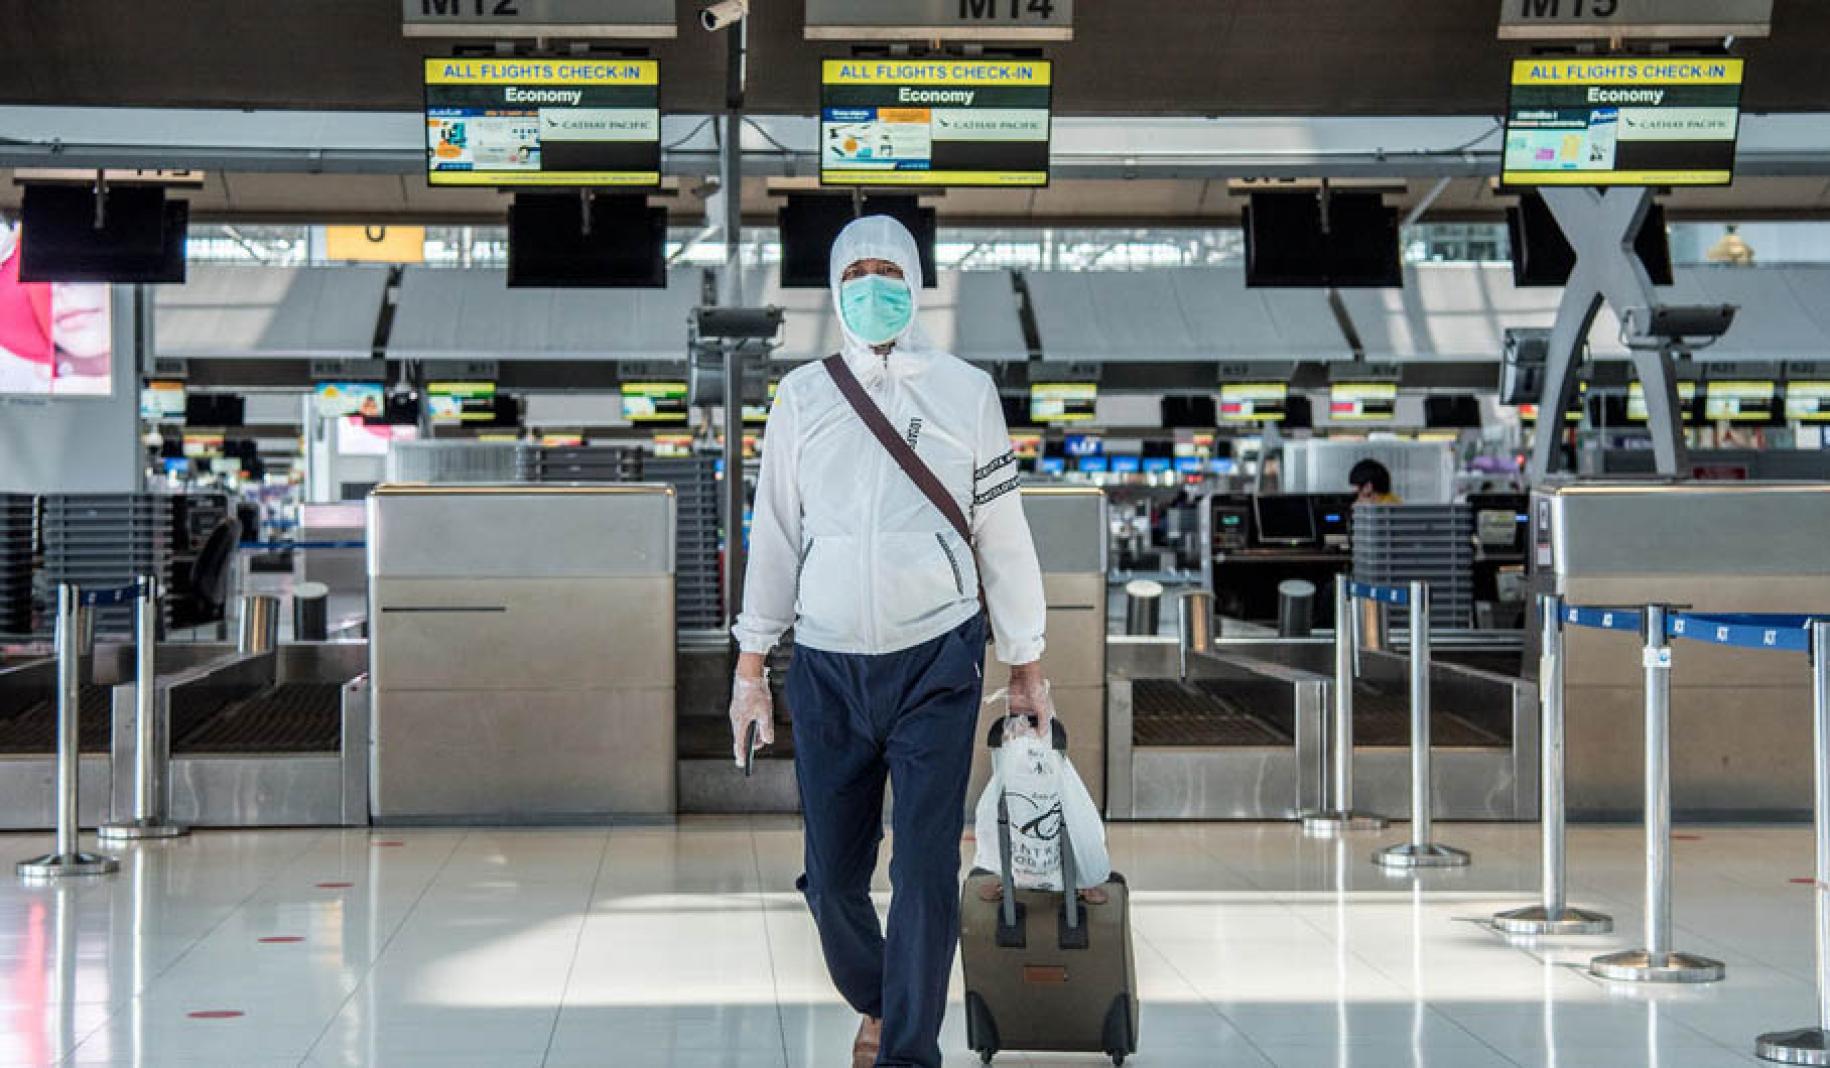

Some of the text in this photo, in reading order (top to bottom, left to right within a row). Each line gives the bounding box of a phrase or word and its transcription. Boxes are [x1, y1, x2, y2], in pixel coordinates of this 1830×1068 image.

[443, 64, 640, 79] ALL FLIGHTS CHECK-IN
[839, 65, 1033, 80] ALL FLIGHTS CHECK-IN
[1530, 65, 1725, 80] ALL FLIGHTS CHECK-IN
[504, 86, 583, 106] Economy
[898, 87, 975, 106] Economy
[1587, 86, 1664, 105] Economy
